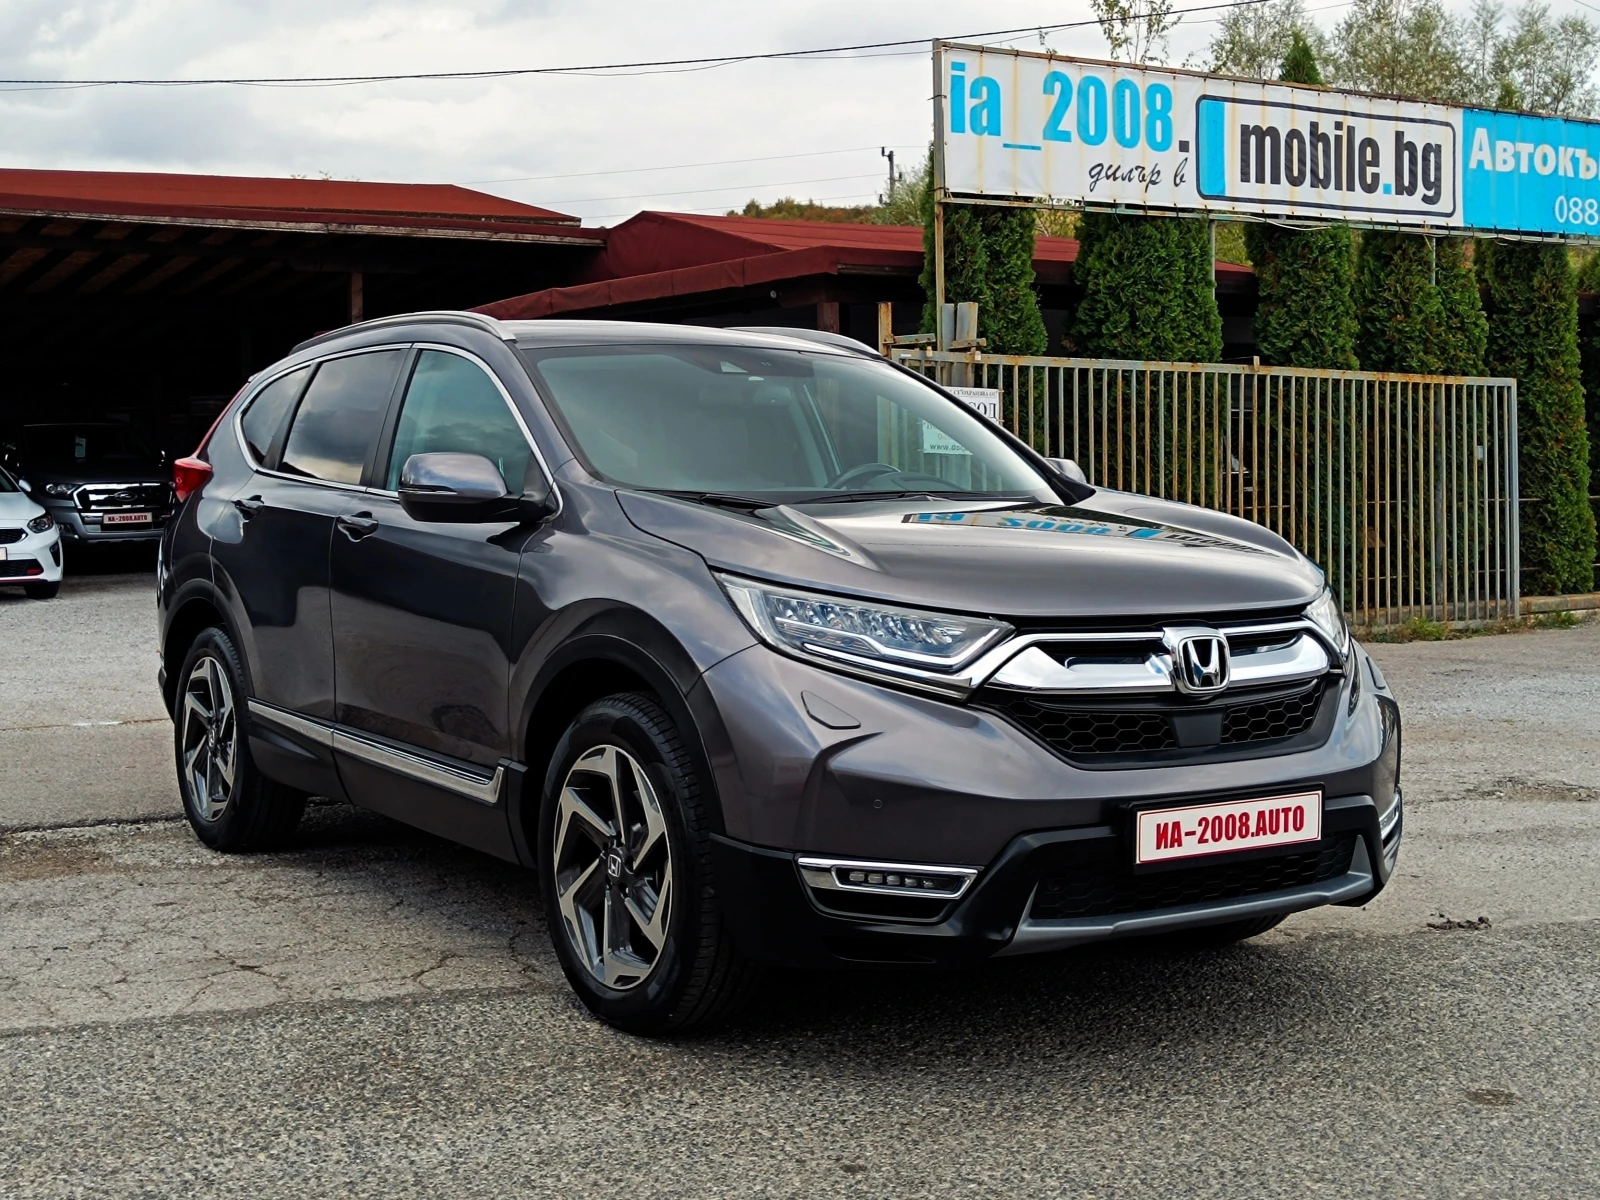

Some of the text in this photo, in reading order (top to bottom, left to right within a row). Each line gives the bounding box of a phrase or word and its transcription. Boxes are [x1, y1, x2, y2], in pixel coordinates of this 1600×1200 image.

[1089, 161, 1162, 193] дилър
[1240, 120, 1443, 206] mobile.bg
[1468, 127, 1600, 181] Автокъ
[1554, 195, 1600, 226] 088
[1155, 804, 1305, 851] ИА-2008.AUTO
